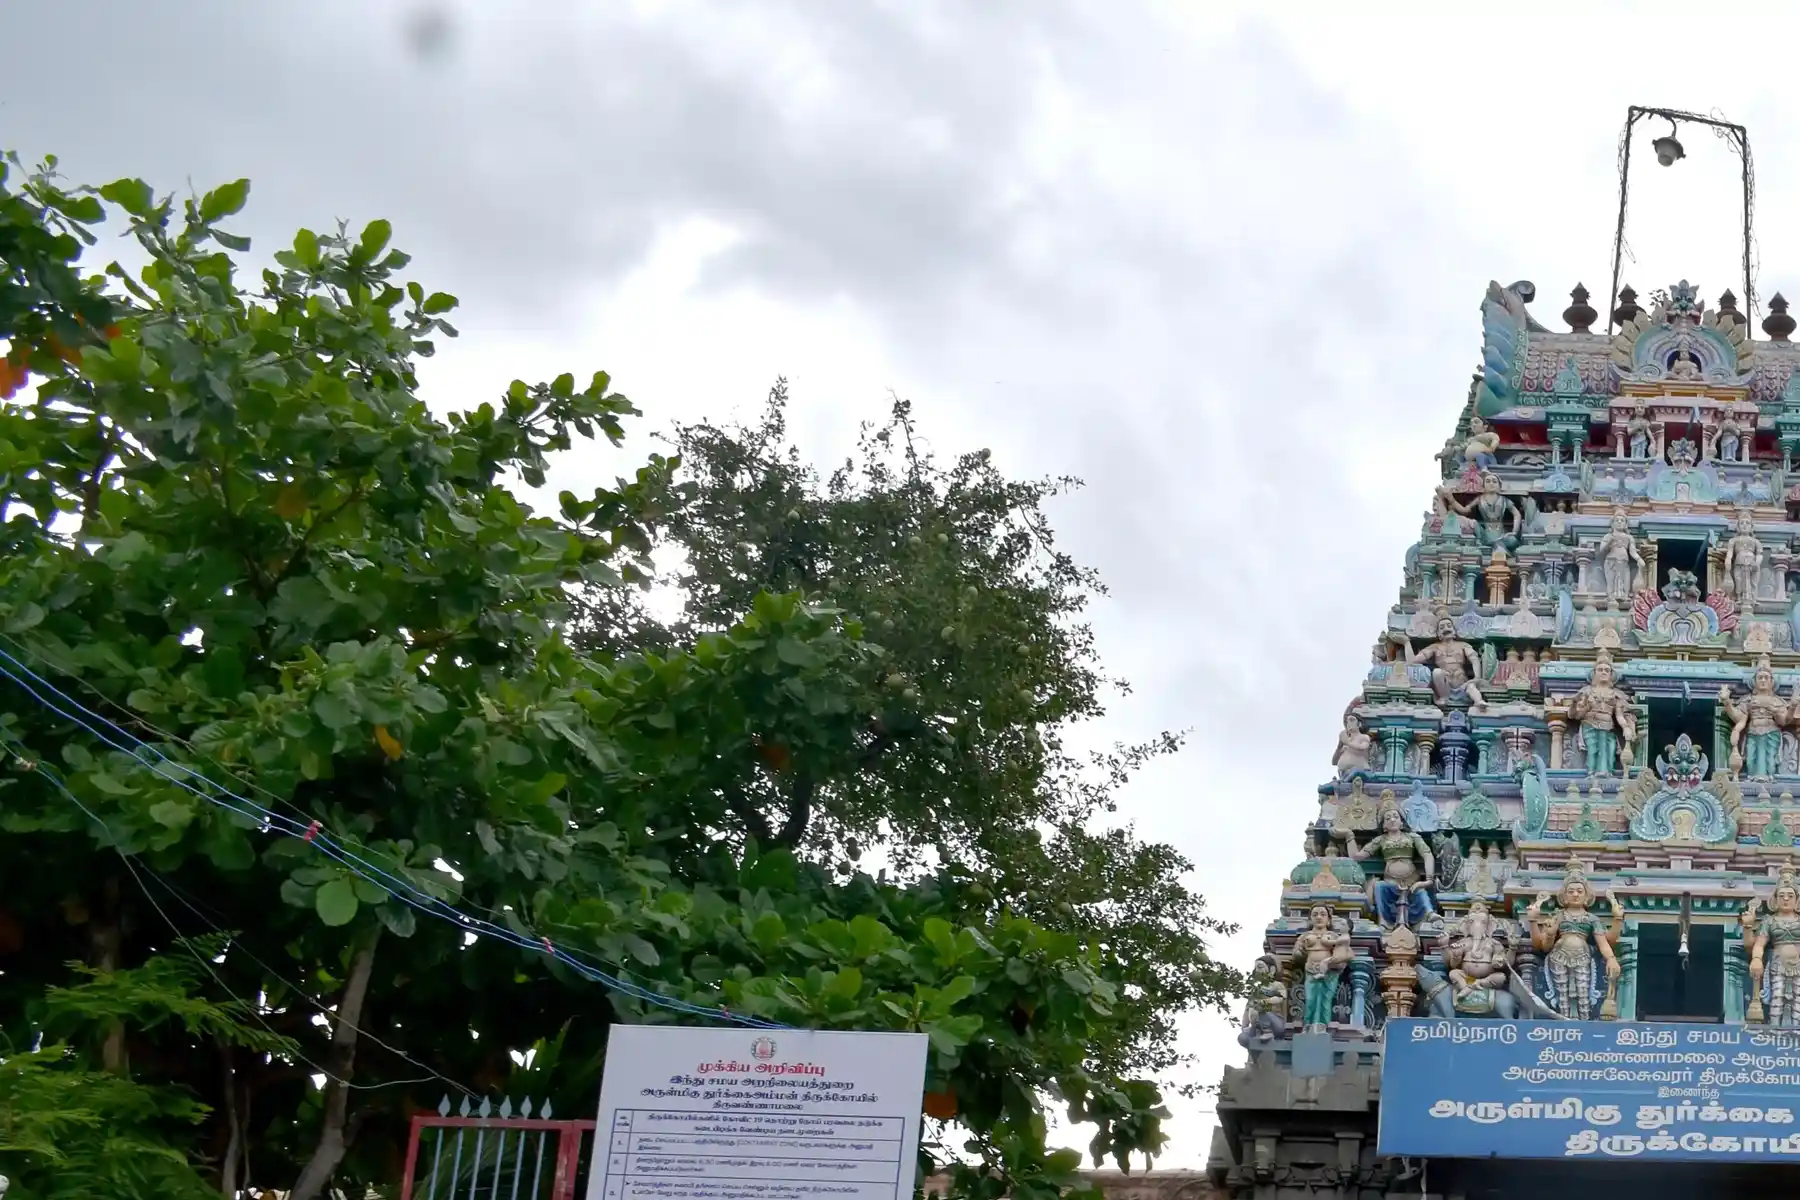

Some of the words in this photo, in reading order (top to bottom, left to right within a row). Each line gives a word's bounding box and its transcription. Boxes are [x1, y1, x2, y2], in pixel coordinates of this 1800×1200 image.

[1411, 1024, 1517, 1044] தமிழ்நாடு
[1527, 1027, 1583, 1044] அரசு
[1616, 1028, 1678, 1048] இந்து
[1686, 1030, 1741, 1045] சமய
[1537, 1046, 1726, 1066] திருவண்ணாமலை
[696, 1059, 750, 1073] முக்கிய
[754, 1059, 825, 1076] அறிவிப்பு
[1502, 1066, 1692, 1084] அருணாசலேசுவரர்
[668, 1074, 705, 1086] இந்து
[707, 1077, 738, 1085] சமய
[740, 1076, 854, 1090] அறநிலையத்துறை
[640, 1086, 700, 1098] அருள்மிகு
[800, 1090, 878, 1102] திருக்கோயில்
[1657, 1085, 1720, 1101] இணைந்த
[711, 1099, 803, 1110] திருவண்ணாமலை
[1428, 1097, 1623, 1124] அருள்மிகு
[1635, 1100, 1795, 1130] துர்க்கை
